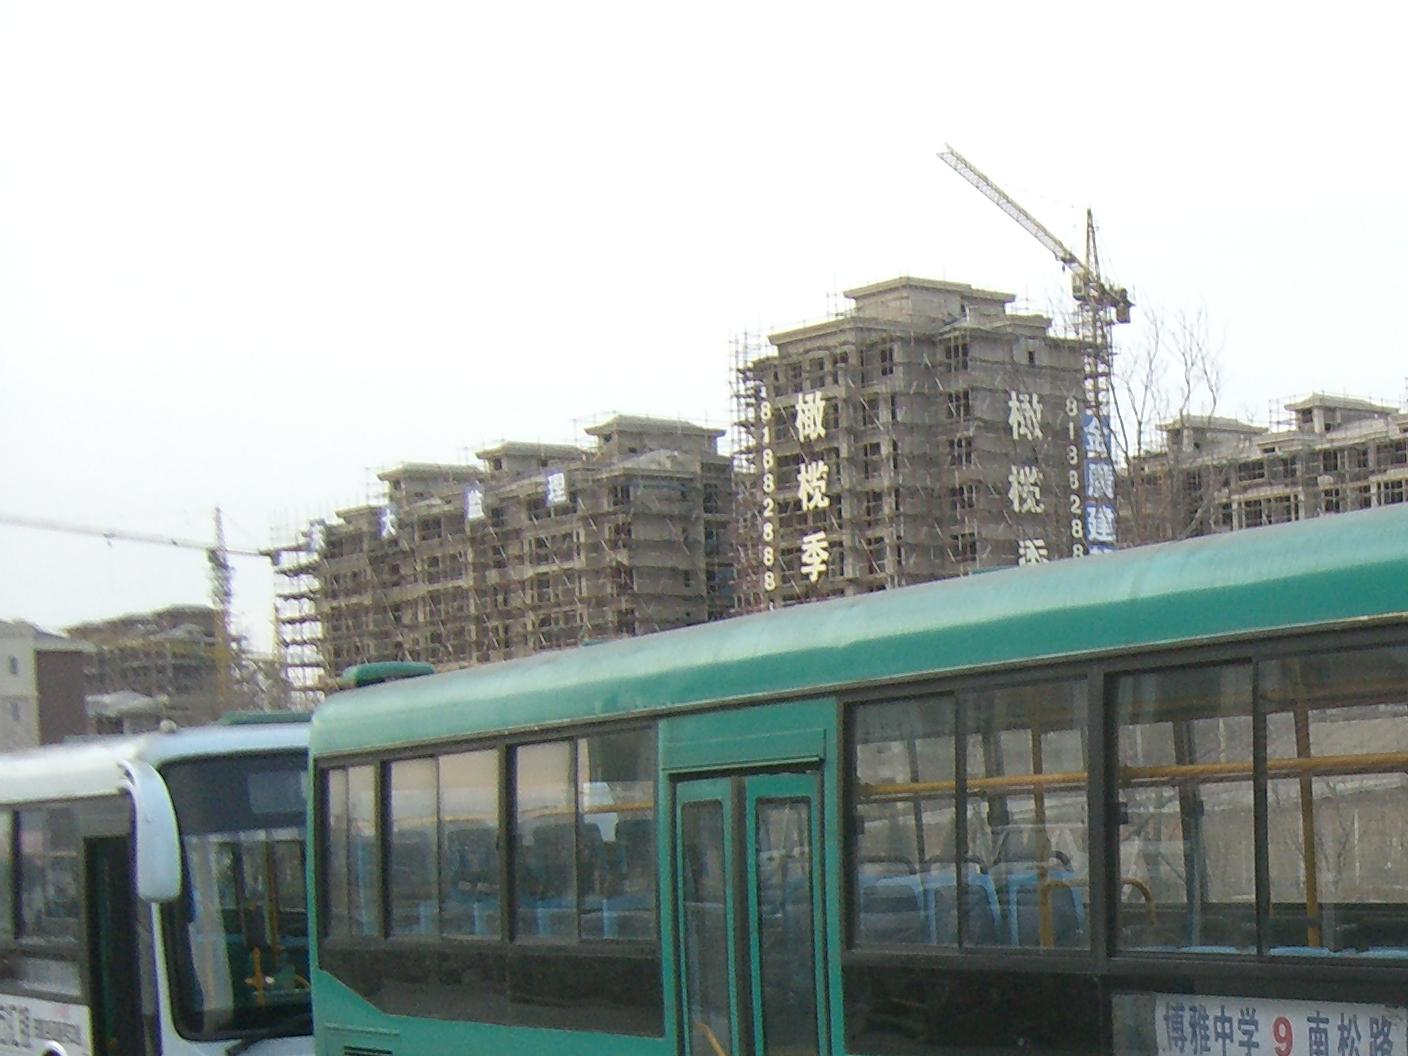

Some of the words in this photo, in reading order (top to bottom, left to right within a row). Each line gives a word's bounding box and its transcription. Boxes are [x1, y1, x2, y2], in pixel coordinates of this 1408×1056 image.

[760, 401, 776, 592] 81882888
[795, 390, 830, 583] 橄榄季
